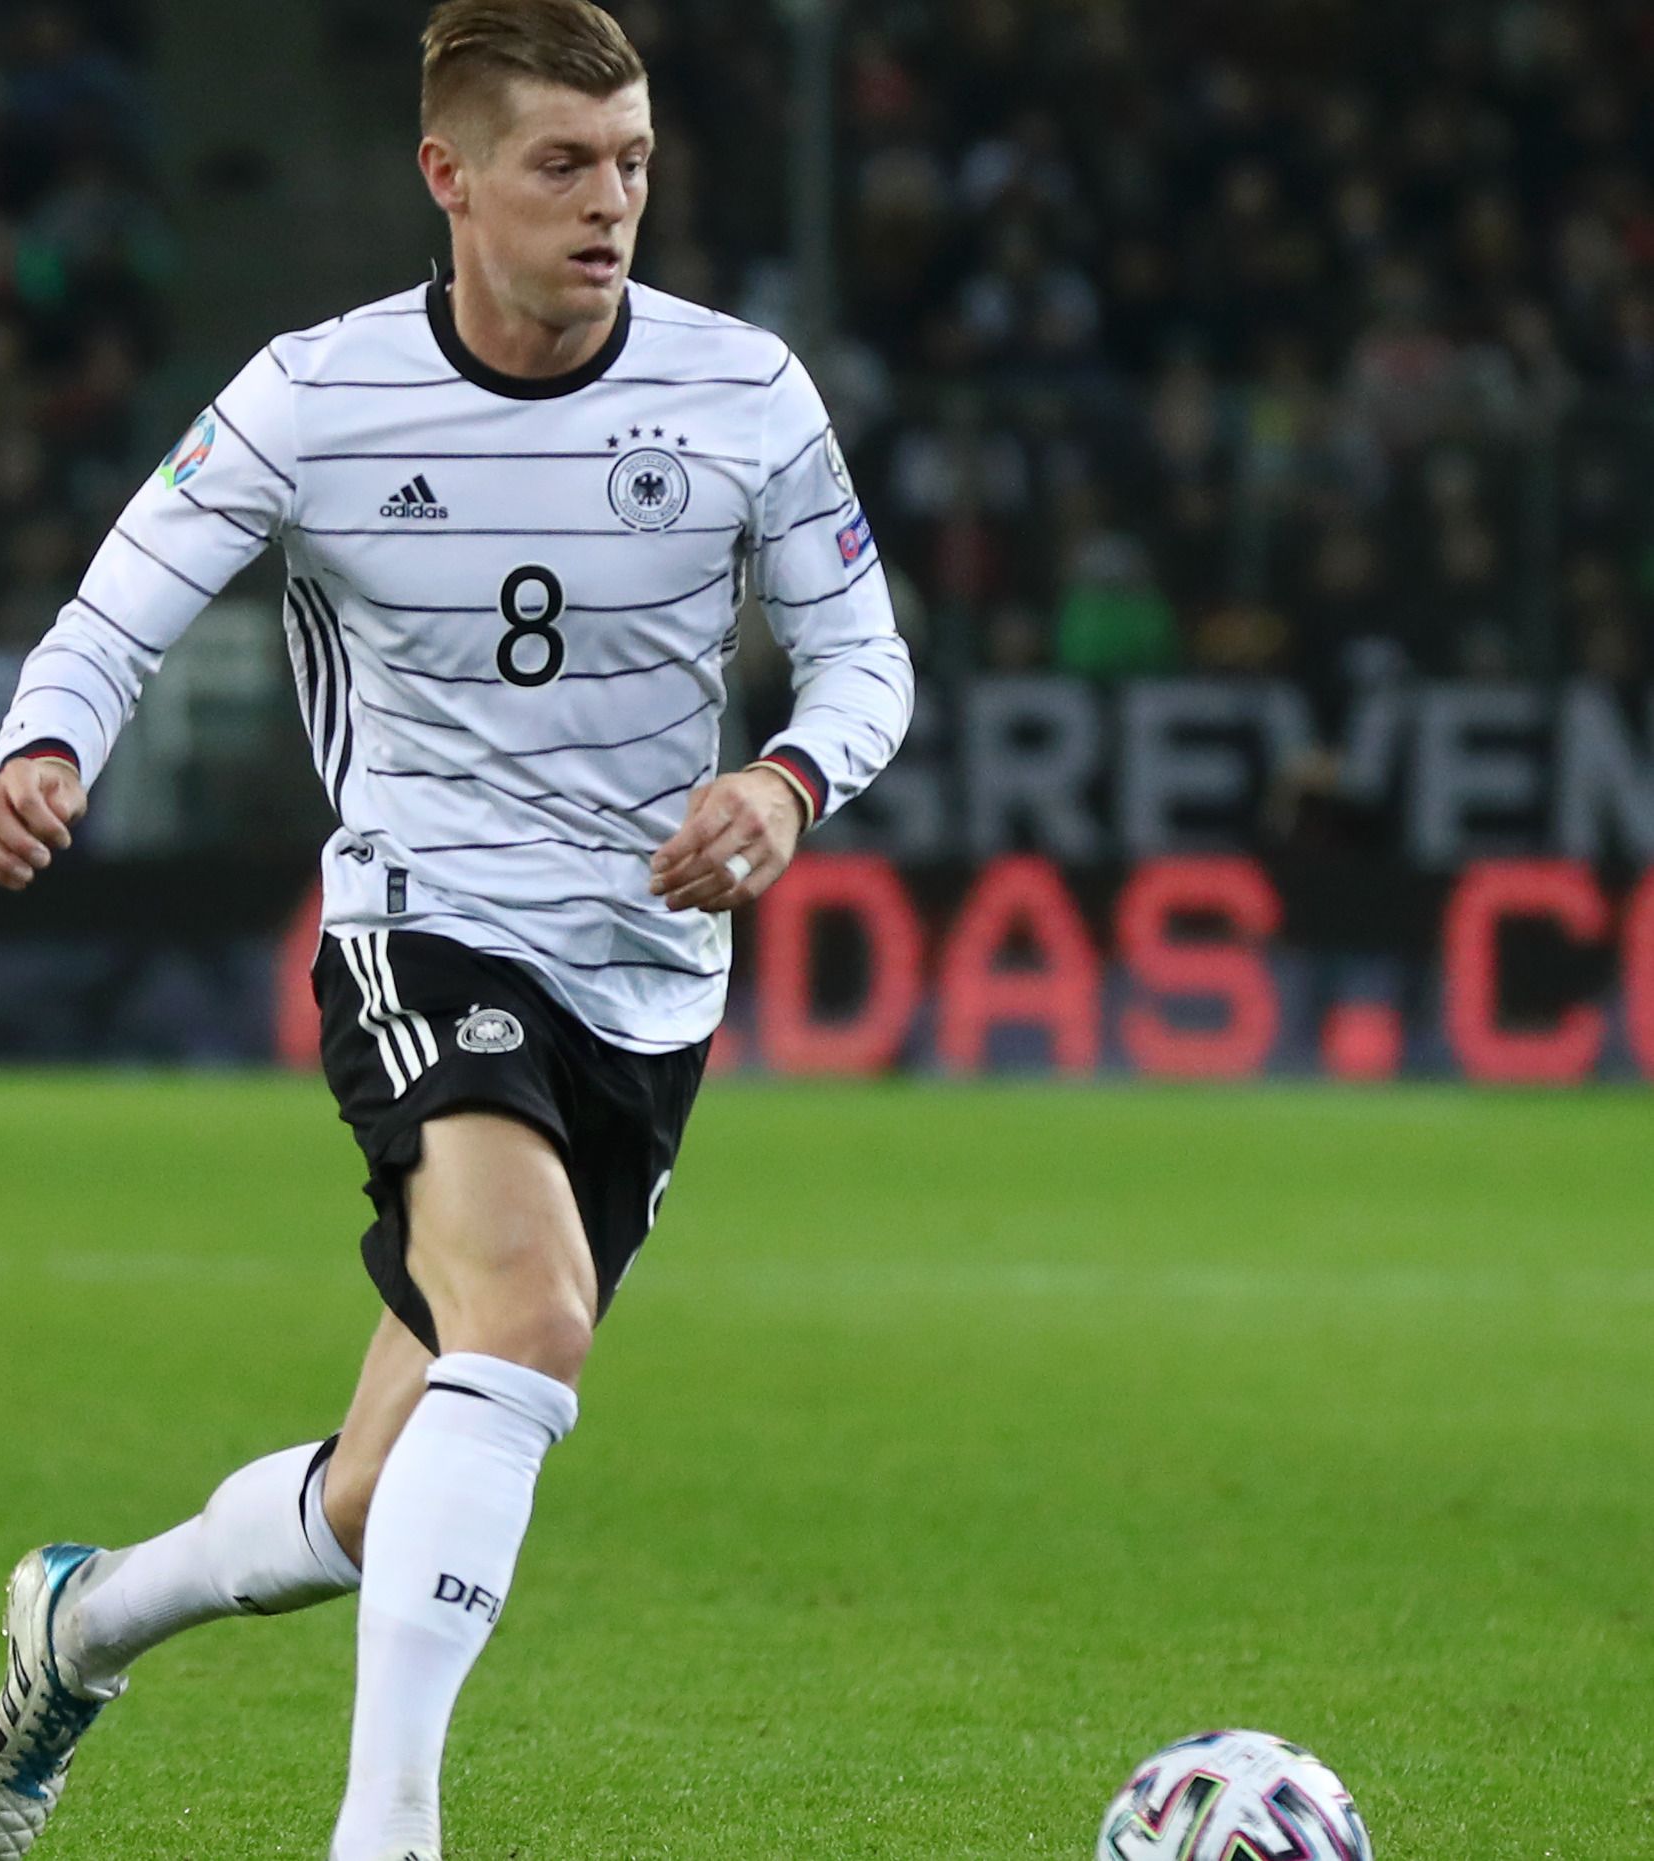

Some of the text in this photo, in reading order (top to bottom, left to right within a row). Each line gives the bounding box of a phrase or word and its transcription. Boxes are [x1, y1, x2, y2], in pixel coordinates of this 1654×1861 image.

[379, 501, 449, 519] adidas
[496, 563, 564, 688] 8
[271, 850, 1654, 1082] DAS.C
